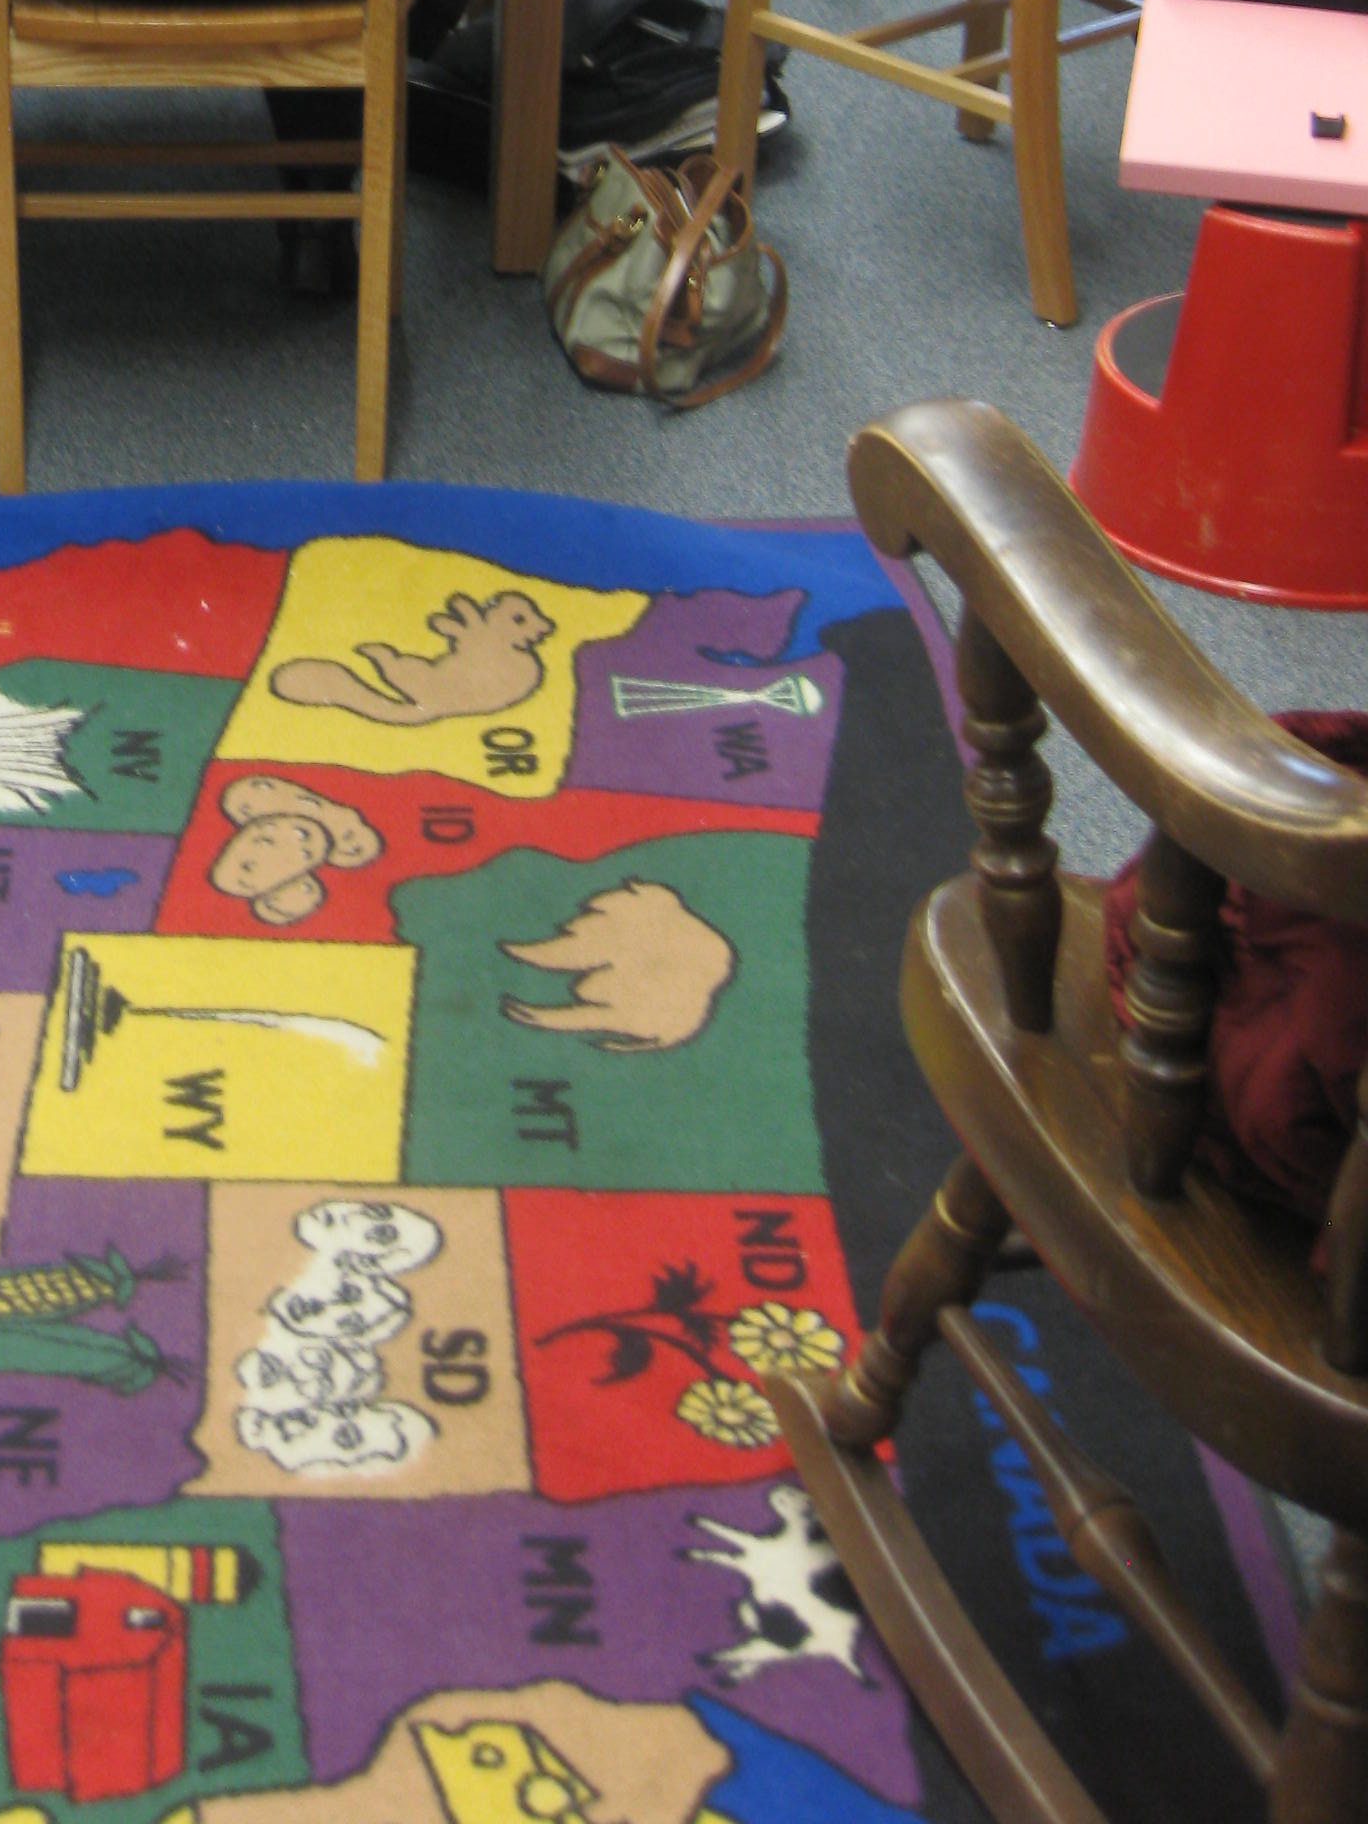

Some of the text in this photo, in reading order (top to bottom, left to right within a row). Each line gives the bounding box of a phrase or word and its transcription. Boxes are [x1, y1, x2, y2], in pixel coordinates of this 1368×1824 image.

[111, 728, 163, 783] NV
[480, 726, 539, 780] OR
[713, 721, 772, 781] WA
[420, 803, 477, 845] ID
[162, 1067, 226, 1152] WY
[511, 1077, 579, 1152] MT
[732, 1209, 808, 1293] ND
[419, 1326, 491, 1407] SD
[520, 1533, 602, 1647] MN
[197, 1682, 274, 1772] IA
